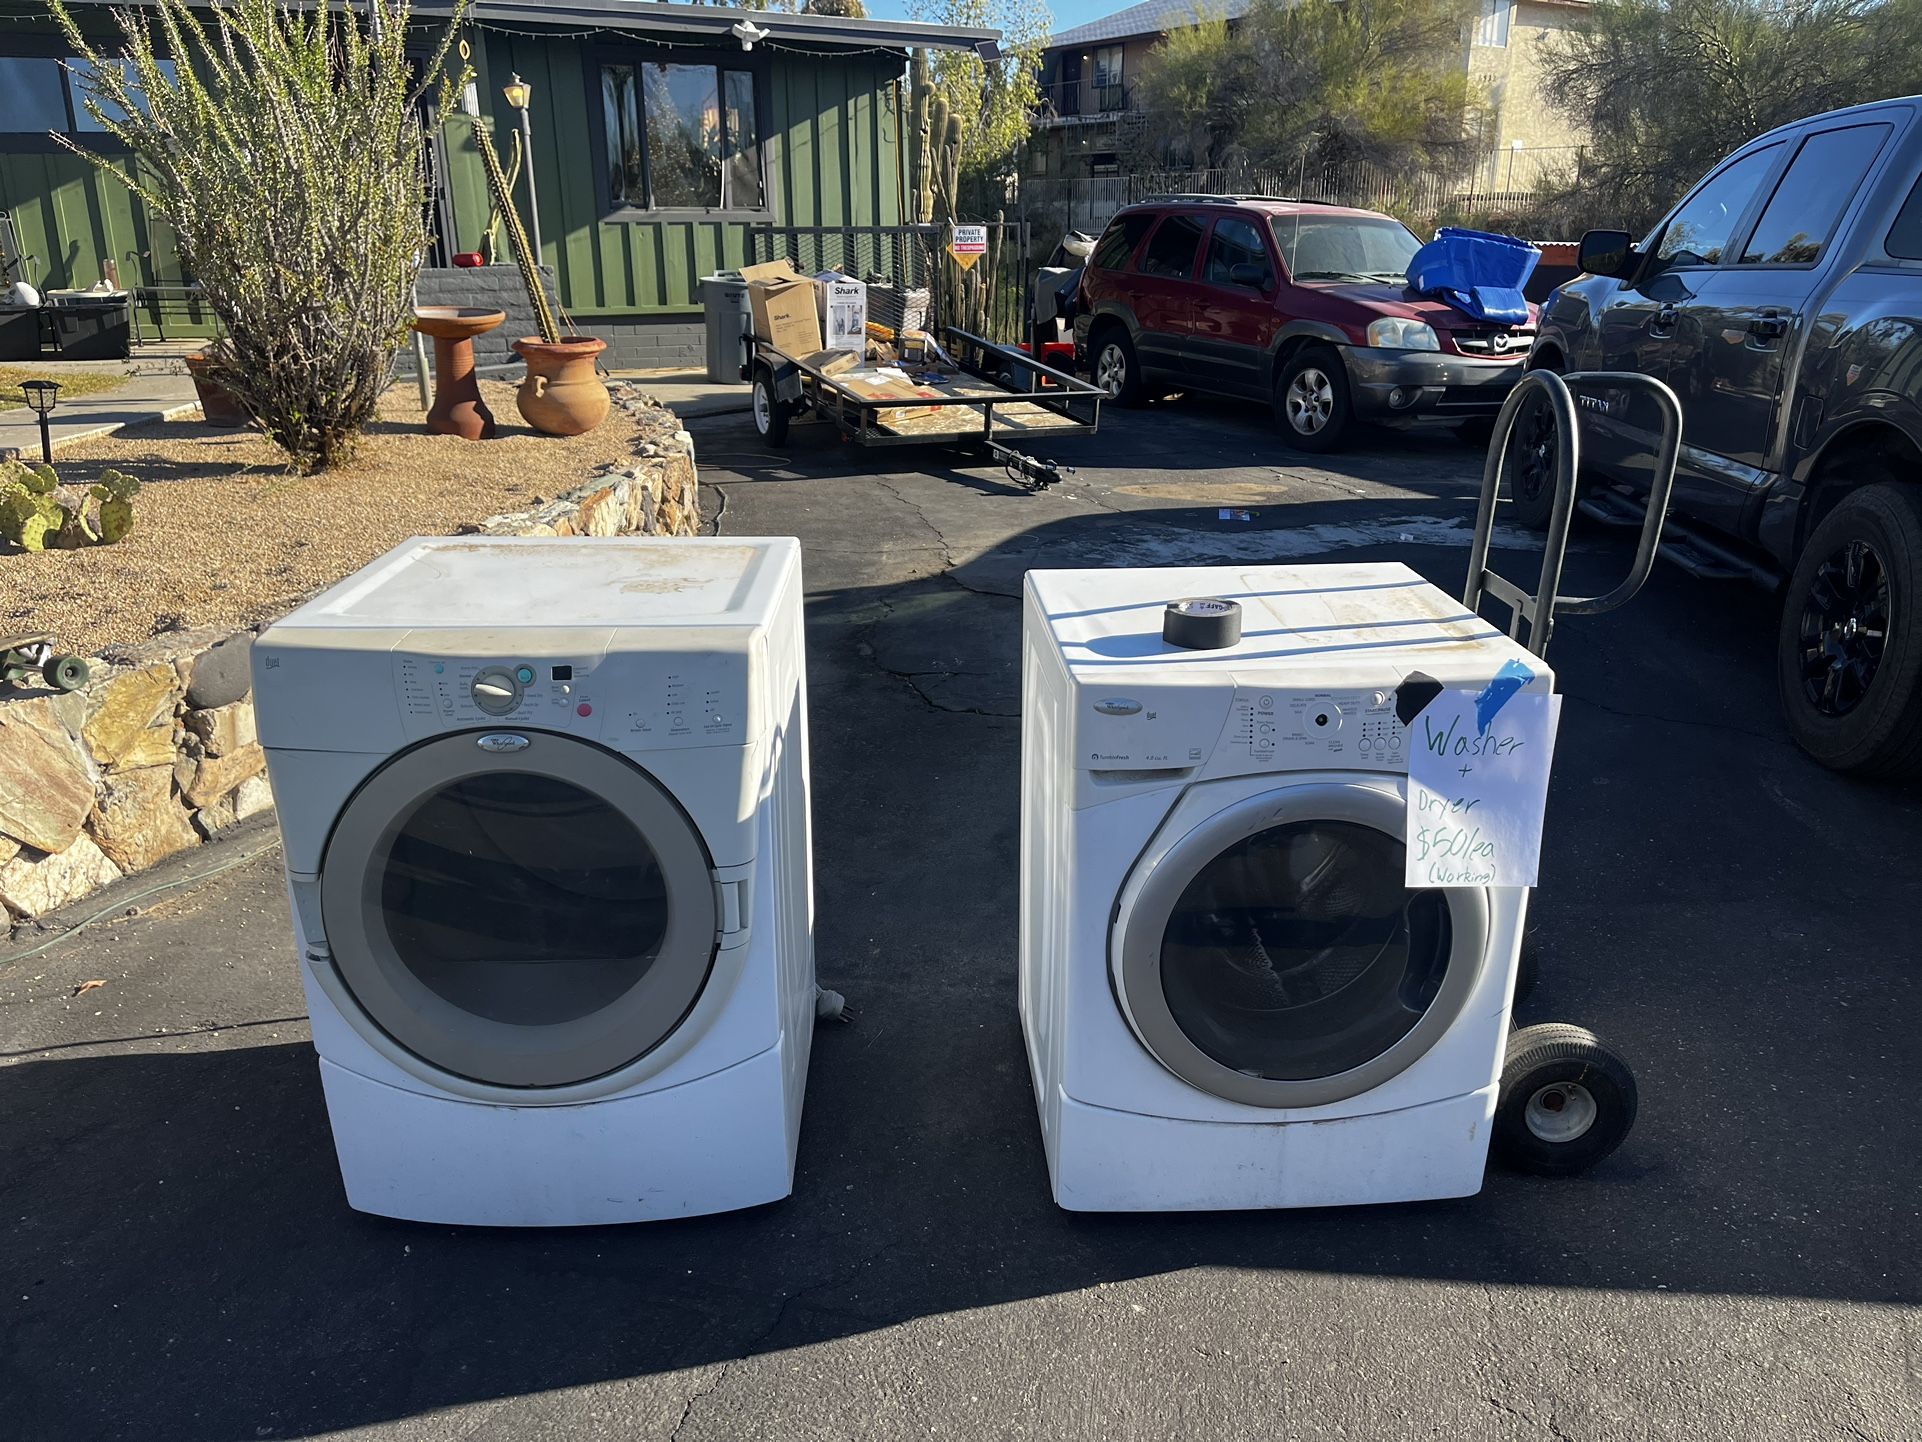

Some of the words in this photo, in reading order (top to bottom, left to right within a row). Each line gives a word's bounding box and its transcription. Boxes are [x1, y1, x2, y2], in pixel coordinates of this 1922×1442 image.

[834, 286, 860, 295] Shark
[1580, 395, 1609, 412] TITAN
[1425, 715, 1525, 757] Washer
[1418, 789, 1481, 820] Dryer
[1416, 825, 1496, 861] $50/ea
[1428, 863, 1497, 885] (Working)
